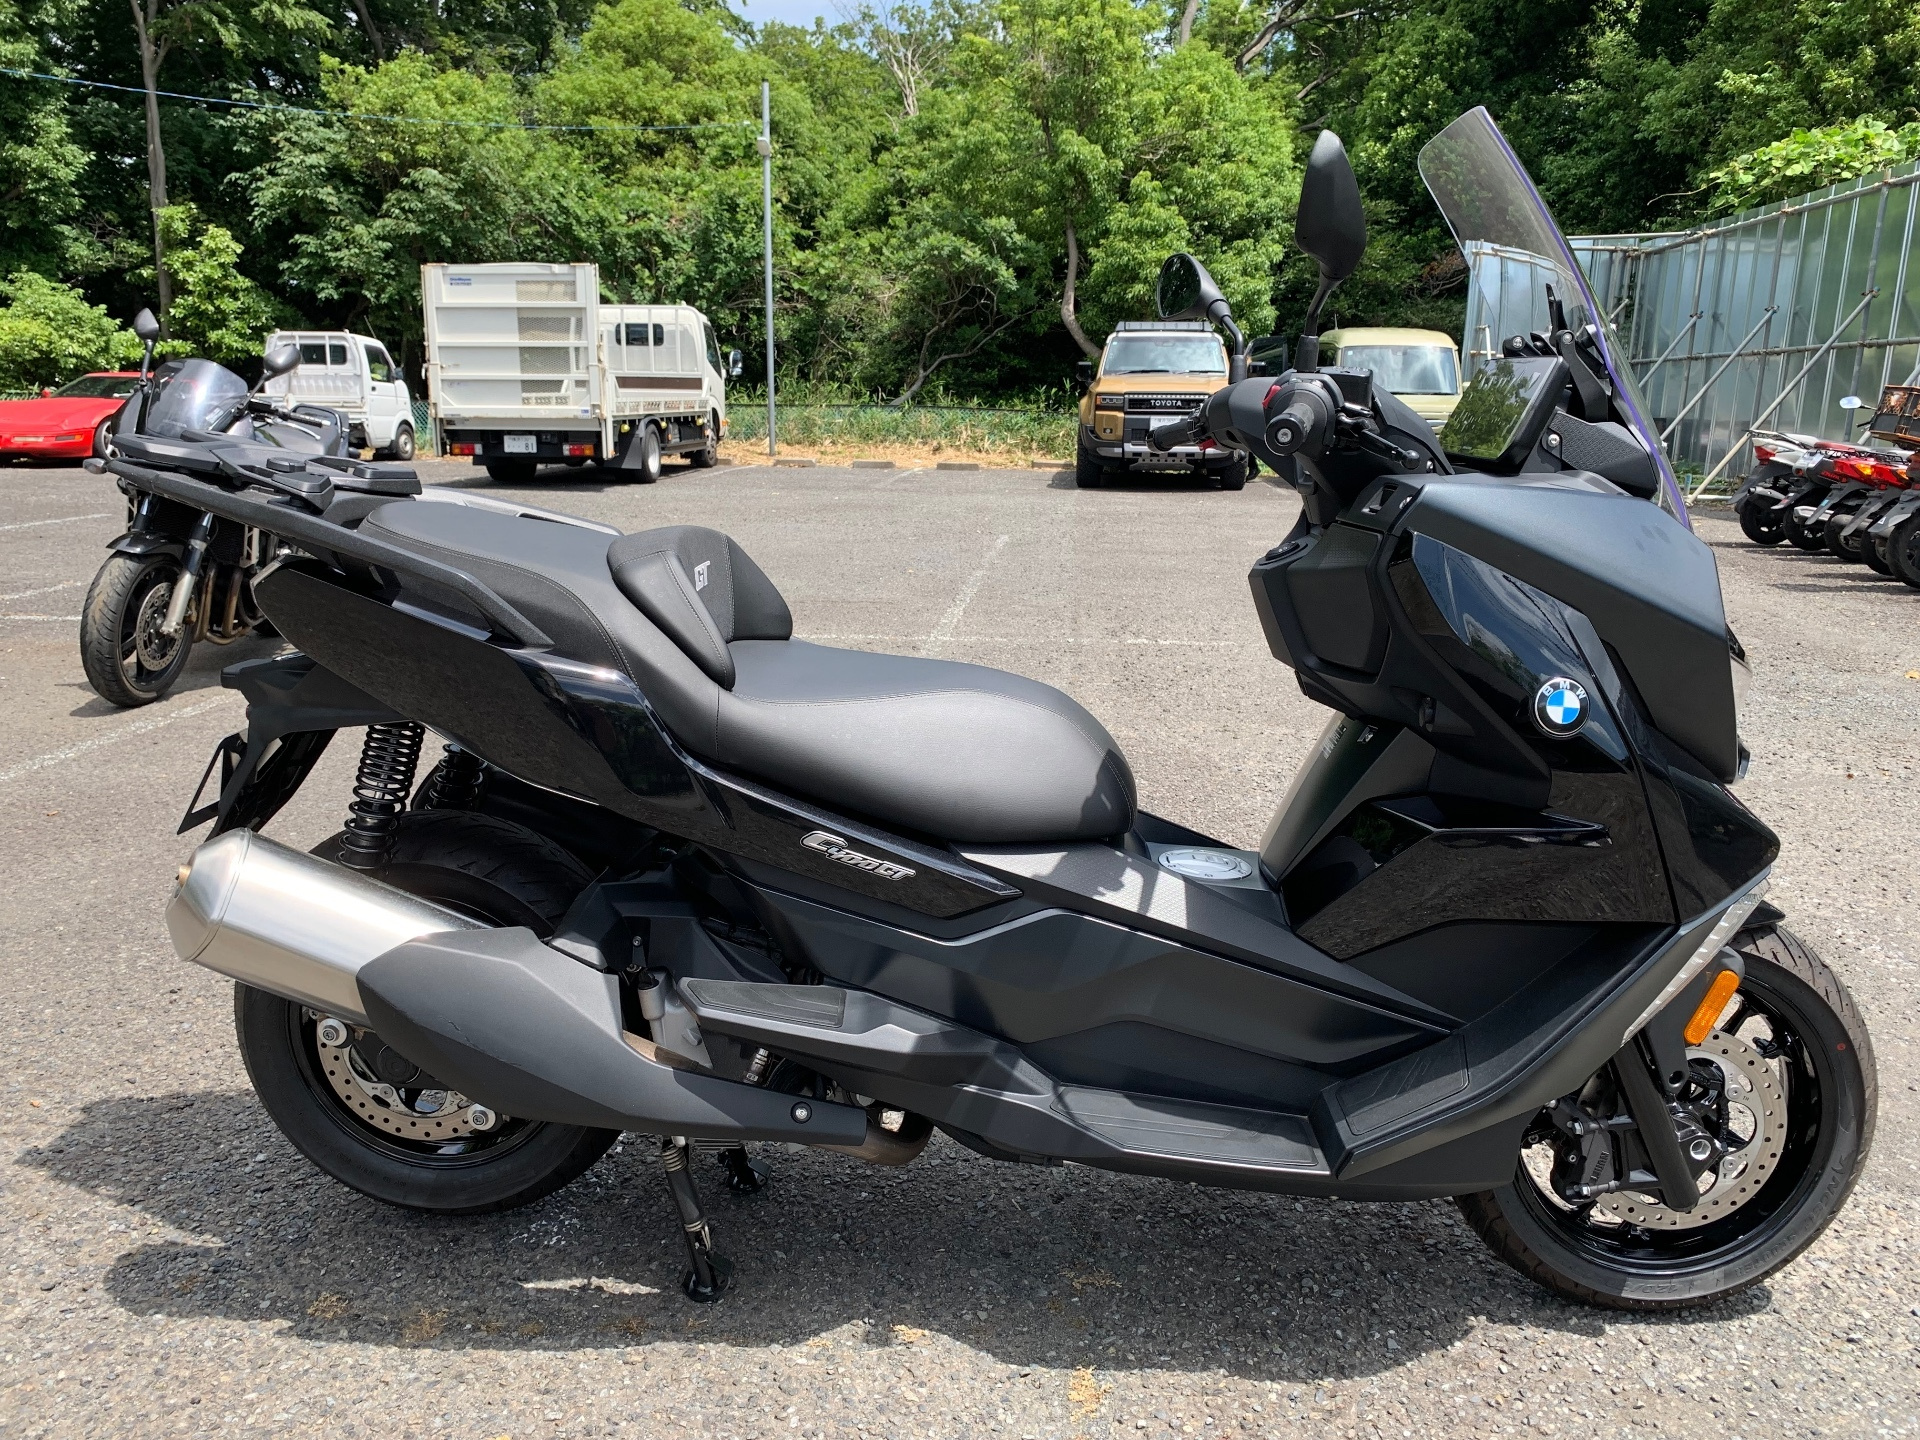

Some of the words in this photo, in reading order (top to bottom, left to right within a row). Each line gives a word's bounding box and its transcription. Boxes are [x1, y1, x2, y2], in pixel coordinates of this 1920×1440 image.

[524, 442, 534, 451] 81
[694, 560, 711, 591] GT
[1542, 680, 1587, 699] BMW
